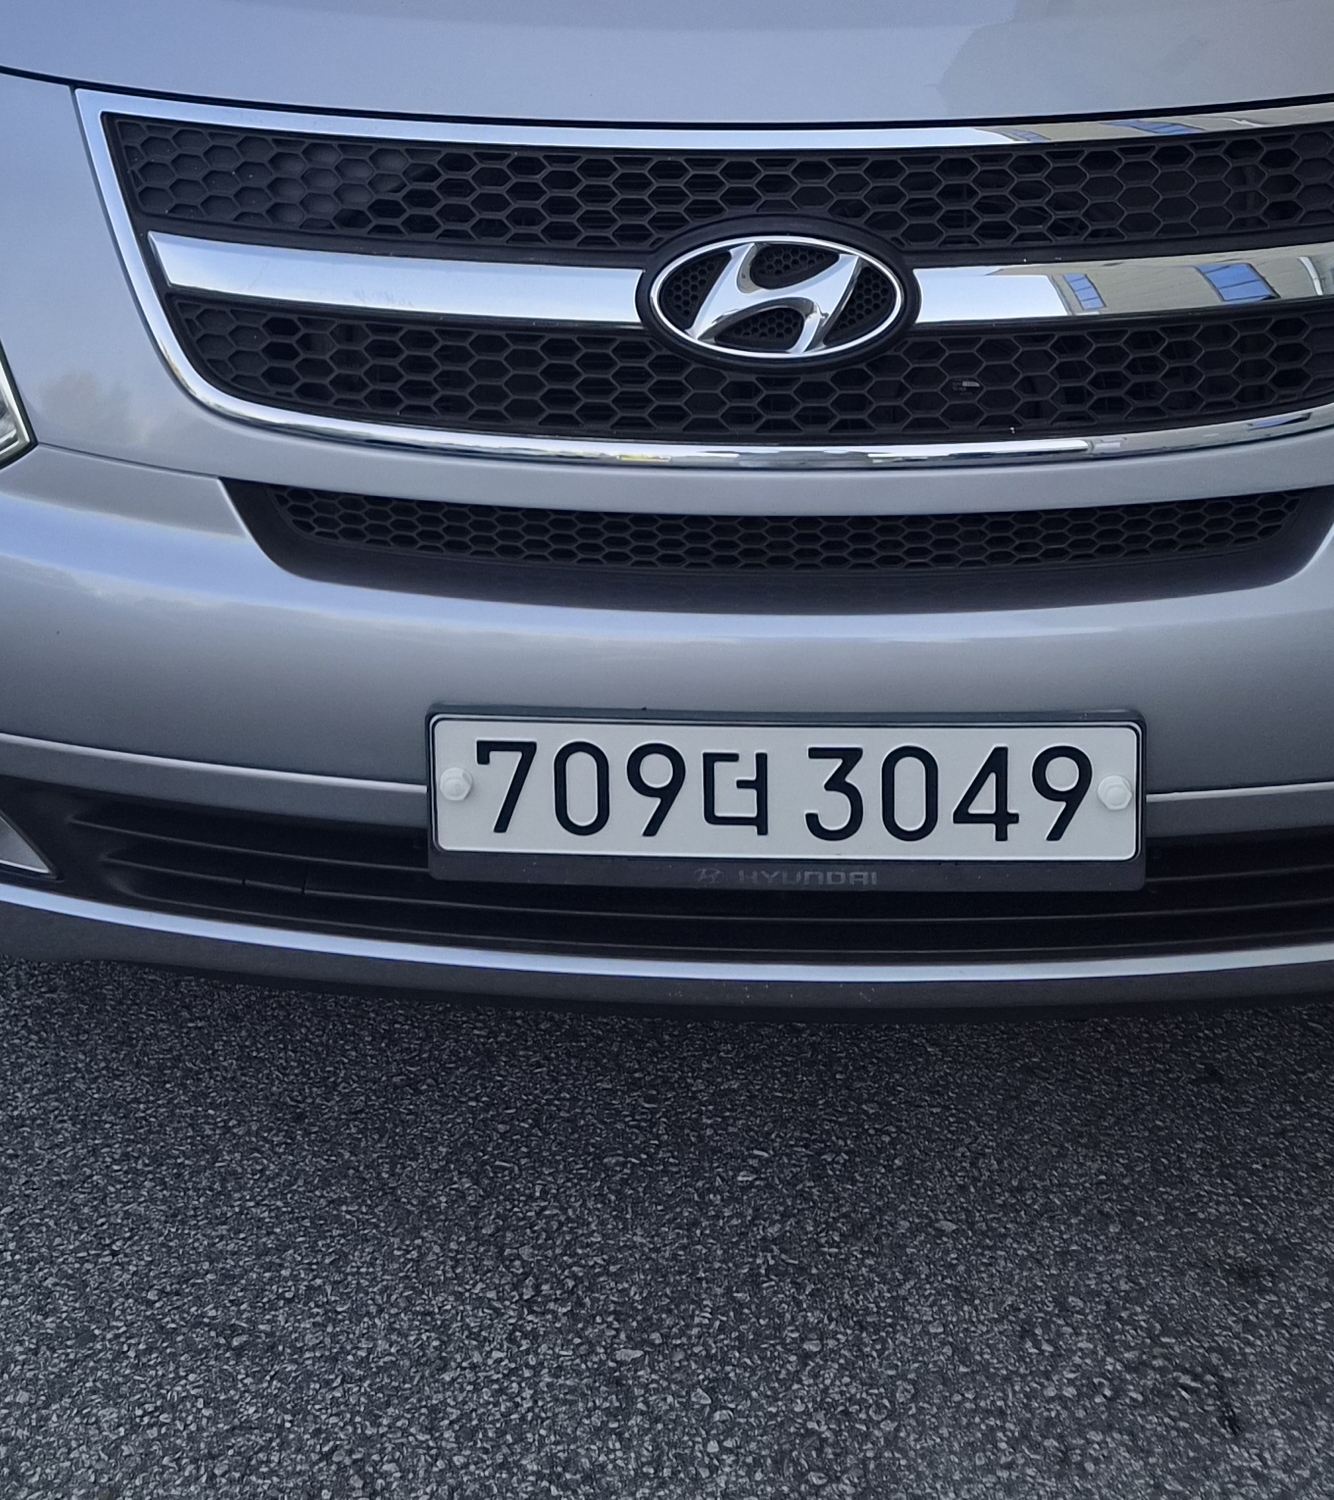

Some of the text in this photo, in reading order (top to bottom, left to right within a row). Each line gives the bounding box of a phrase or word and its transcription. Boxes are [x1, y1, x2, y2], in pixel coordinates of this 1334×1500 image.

[475, 739, 1093, 843] 709더 3049
[738, 869, 877, 886] HYUNDAI
